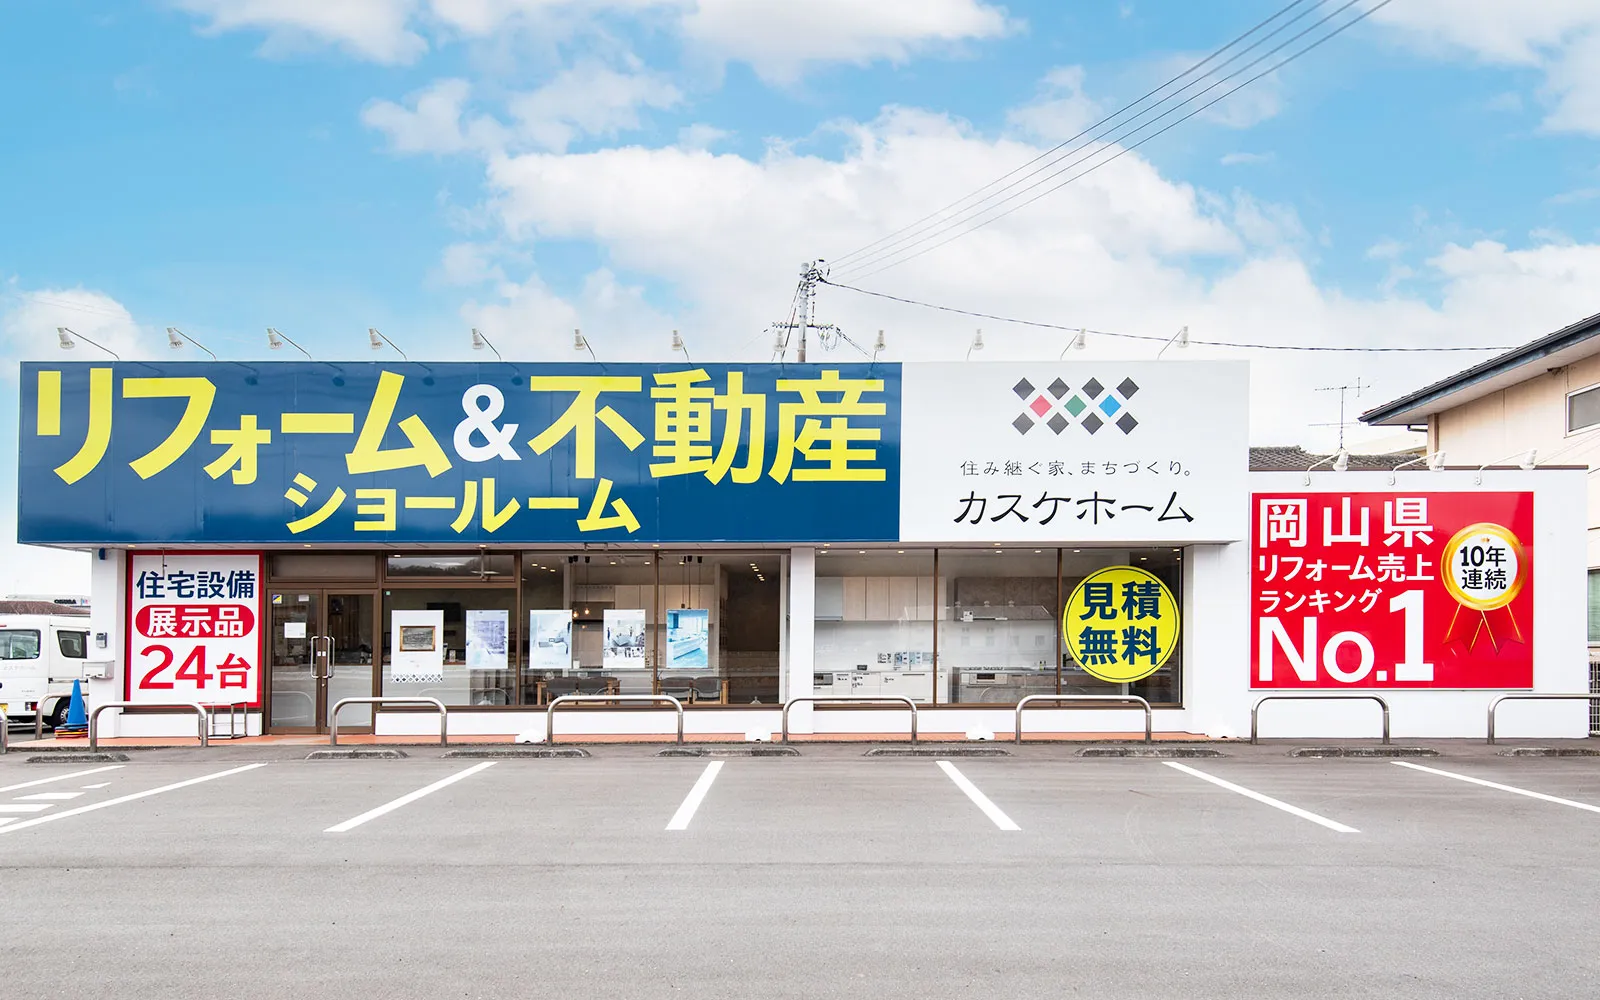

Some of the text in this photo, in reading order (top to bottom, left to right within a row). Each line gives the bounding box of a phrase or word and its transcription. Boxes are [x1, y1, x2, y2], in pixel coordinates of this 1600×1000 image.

[37, 368, 886, 485] リフォーム&不動産
[961, 460, 1191, 476] 住み継ぐ家、まちづくり。
[284, 472, 640, 533] ショールーム
[954, 491, 1194, 525] カスケホーム
[1259, 497, 1434, 547] 岡山県
[1259, 553, 1434, 582] リフォーム売上
[1460, 546, 1506, 567] 10年
[136, 571, 255, 599] 住宅設備
[1462, 569, 1507, 590] 連続
[1078, 580, 1162, 620] 見積
[1259, 589, 1382, 613] ランキング
[147, 608, 244, 637] 展示品
[1259, 590, 1434, 682] No.1
[1078, 626, 1162, 665] 無料
[139, 645, 251, 689] 24台
